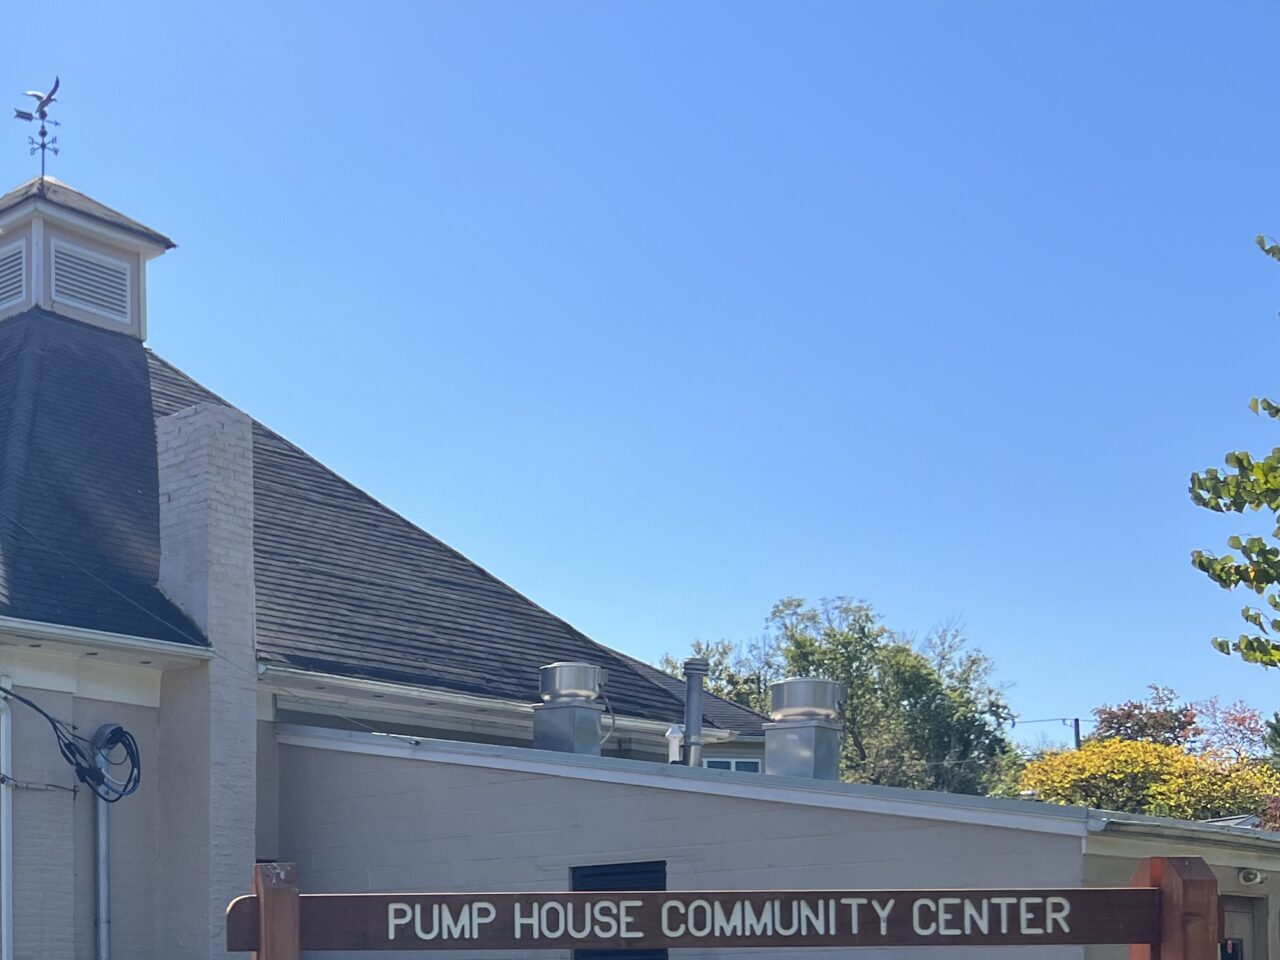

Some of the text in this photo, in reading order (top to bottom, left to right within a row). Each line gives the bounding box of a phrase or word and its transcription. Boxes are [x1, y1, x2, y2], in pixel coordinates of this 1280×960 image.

[387, 895, 1071, 941] PUMP HOUSE COMMUNITY CENTER
